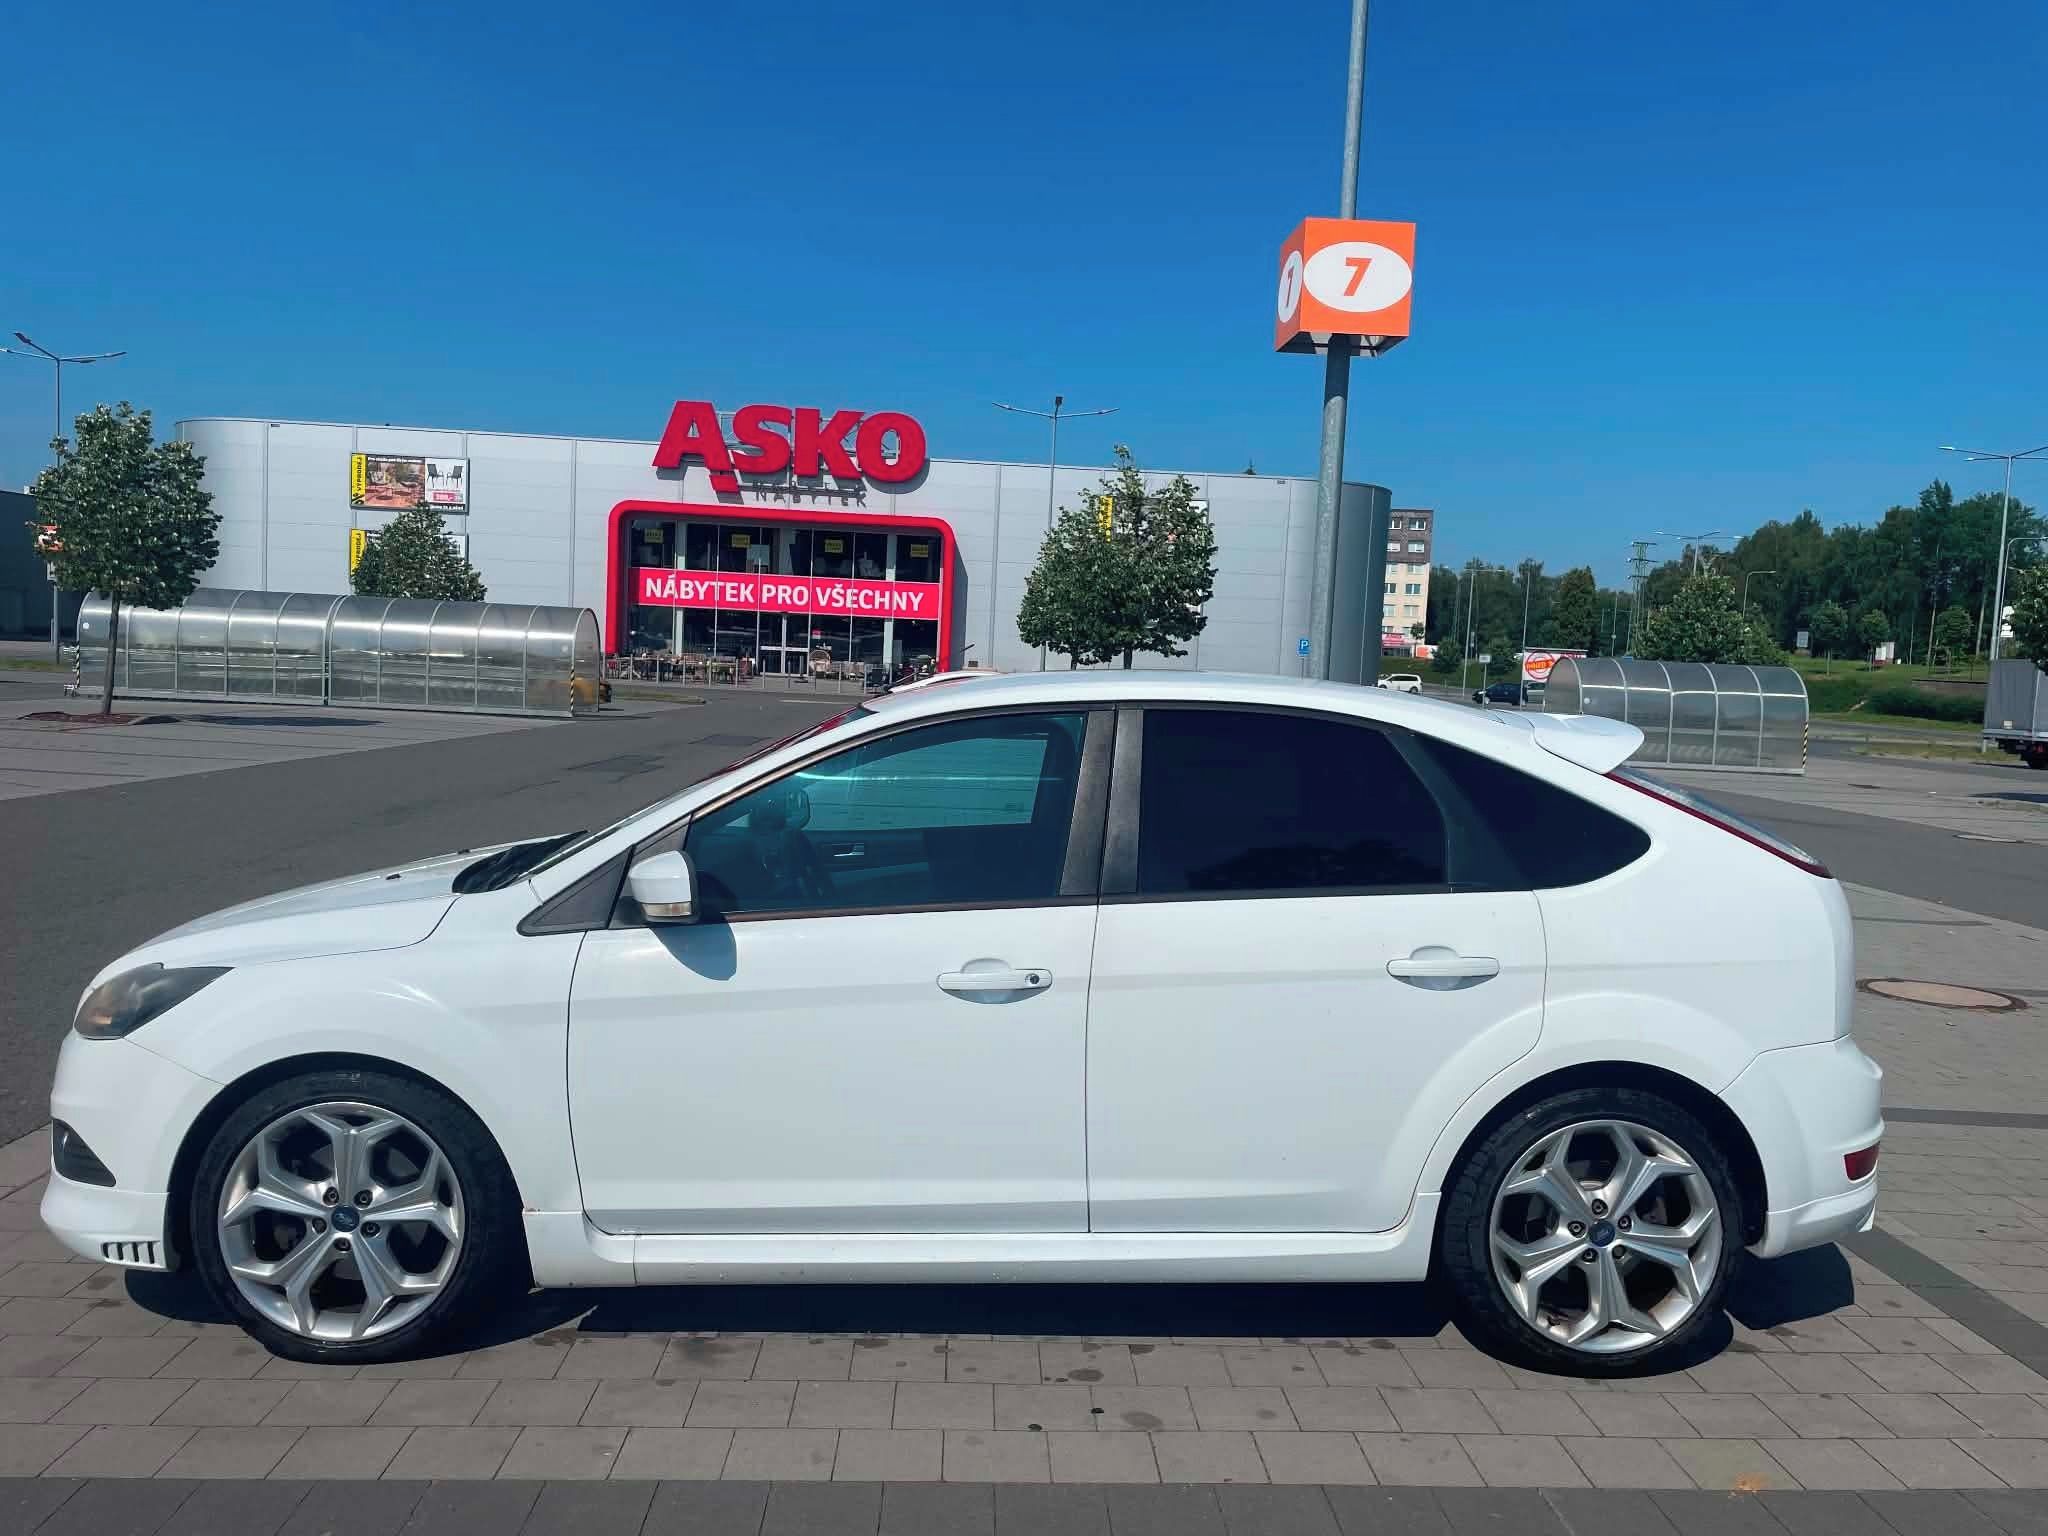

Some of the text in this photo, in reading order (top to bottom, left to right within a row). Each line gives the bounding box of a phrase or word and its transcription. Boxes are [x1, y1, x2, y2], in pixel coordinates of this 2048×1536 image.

[1343, 256, 1373, 297] 7
[652, 400, 926, 490] ASKO
[645, 574, 925, 612] NÁBYTEK PRO VŠECHNY
